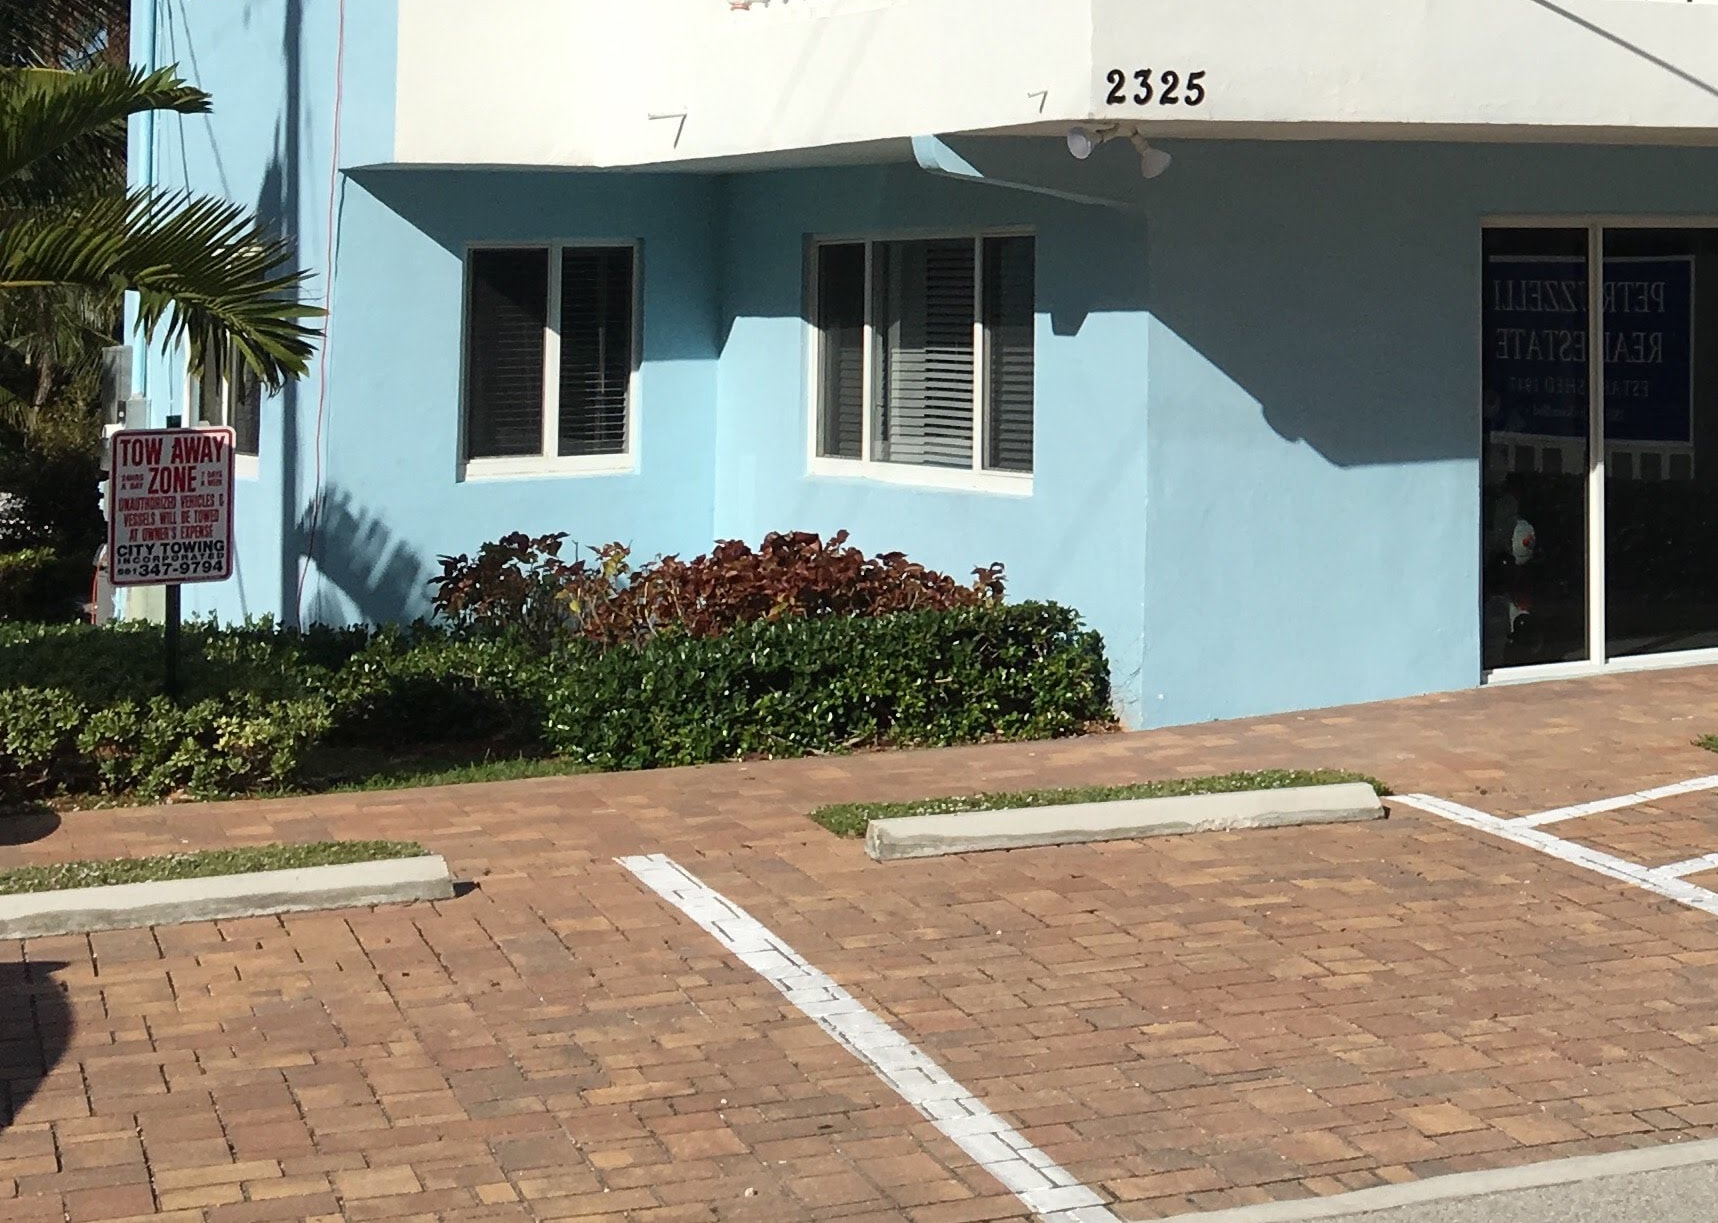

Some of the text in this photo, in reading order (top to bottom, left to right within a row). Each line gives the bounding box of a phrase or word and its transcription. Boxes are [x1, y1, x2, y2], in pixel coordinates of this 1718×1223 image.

[1106, 68, 1206, 107] 2325
[120, 435, 226, 467] TOW AWAY
[147, 465, 198, 495] ZONE
[118, 495, 177, 512] UNAUTHORIZED
[180, 493, 215, 509] VEHICLES
[124, 509, 219, 527] VESSELS WILL BE TOWED
[129, 524, 214, 542] AT OWNER'S EXPENSE
[117, 540, 225, 557] CITY TOWING
[117, 552, 225, 565] INCORPORATED
[138, 560, 224, 577] 347-9794
